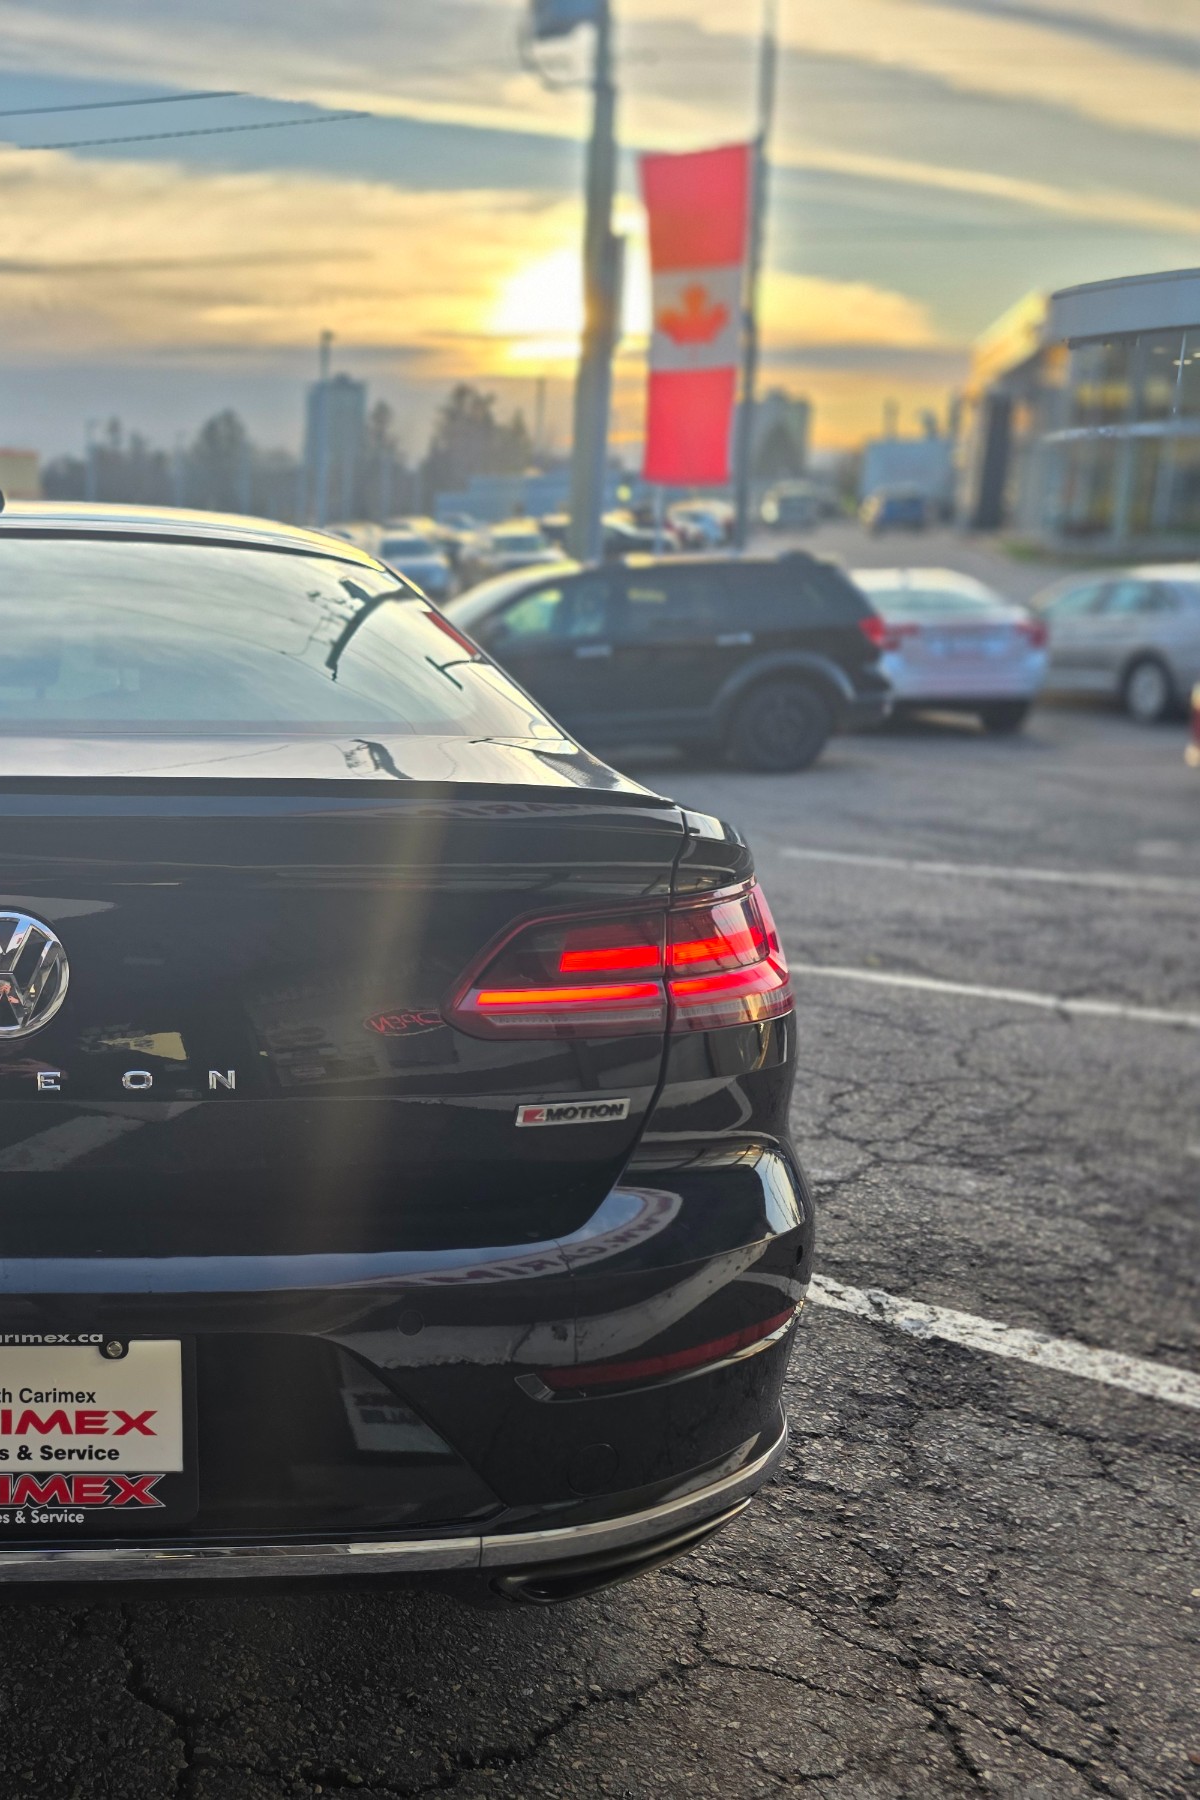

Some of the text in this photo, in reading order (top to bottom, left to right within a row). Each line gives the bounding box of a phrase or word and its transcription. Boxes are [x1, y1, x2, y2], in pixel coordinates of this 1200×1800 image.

[18, 1388, 97, 1404] Carimex
[16, 1445, 33, 1461] &
[39, 1445, 120, 1461] Service
[14, 1511, 27, 1525] &
[30, 1511, 85, 1525] Service
